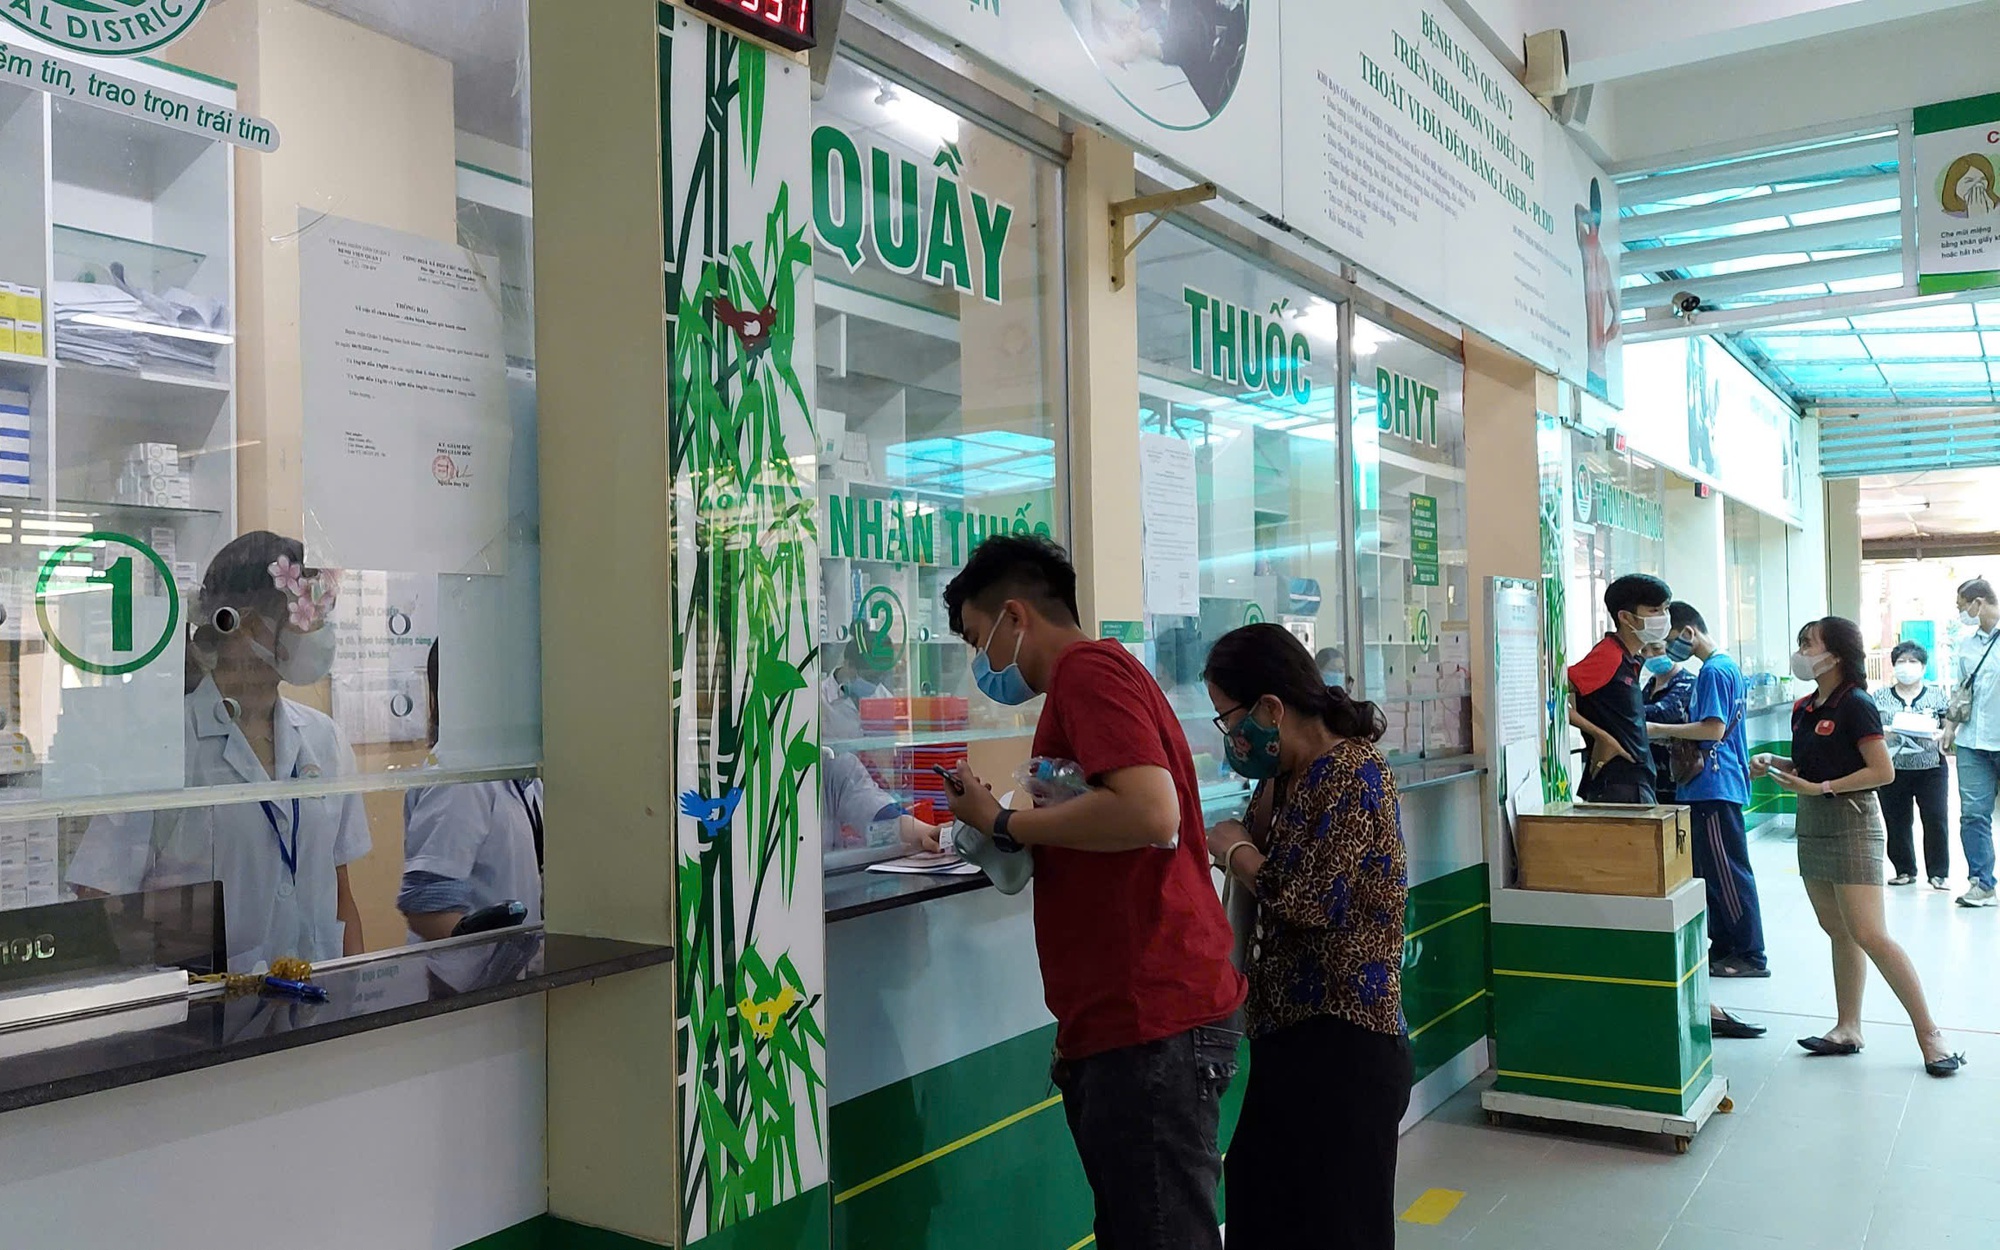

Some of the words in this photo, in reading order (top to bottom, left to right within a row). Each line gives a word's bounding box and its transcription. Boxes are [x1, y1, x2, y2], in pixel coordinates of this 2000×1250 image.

[67, 0, 192, 43] DISTRIC
[41, 60, 76, 96] tin,
[88, 73, 136, 106] trao
[144, 89, 189, 122] trọn
[197, 104, 232, 134] trái
[239, 116, 270, 145] tim
[1359, 51, 1404, 112] THOÁT
[1407, 93, 1420, 131] VỊ
[1499, 172, 1528, 215] LASER
[1533, 201, 1554, 235] PLDD
[1432, 67, 1460, 113] KHAI
[1484, 117, 1494, 150] VỊ
[1508, 99, 1513, 121] 2
[811, 125, 1014, 304] QUẦY
[1941, 231, 1955, 239] Che
[1183, 285, 1311, 405] THUỐC
[1376, 366, 1439, 448] BHYT
[829, 489, 934, 572] NHẬN
[86, 556, 133, 652] 1
[870, 599, 894, 658] 2
[1420, 616, 1428, 646] 4
